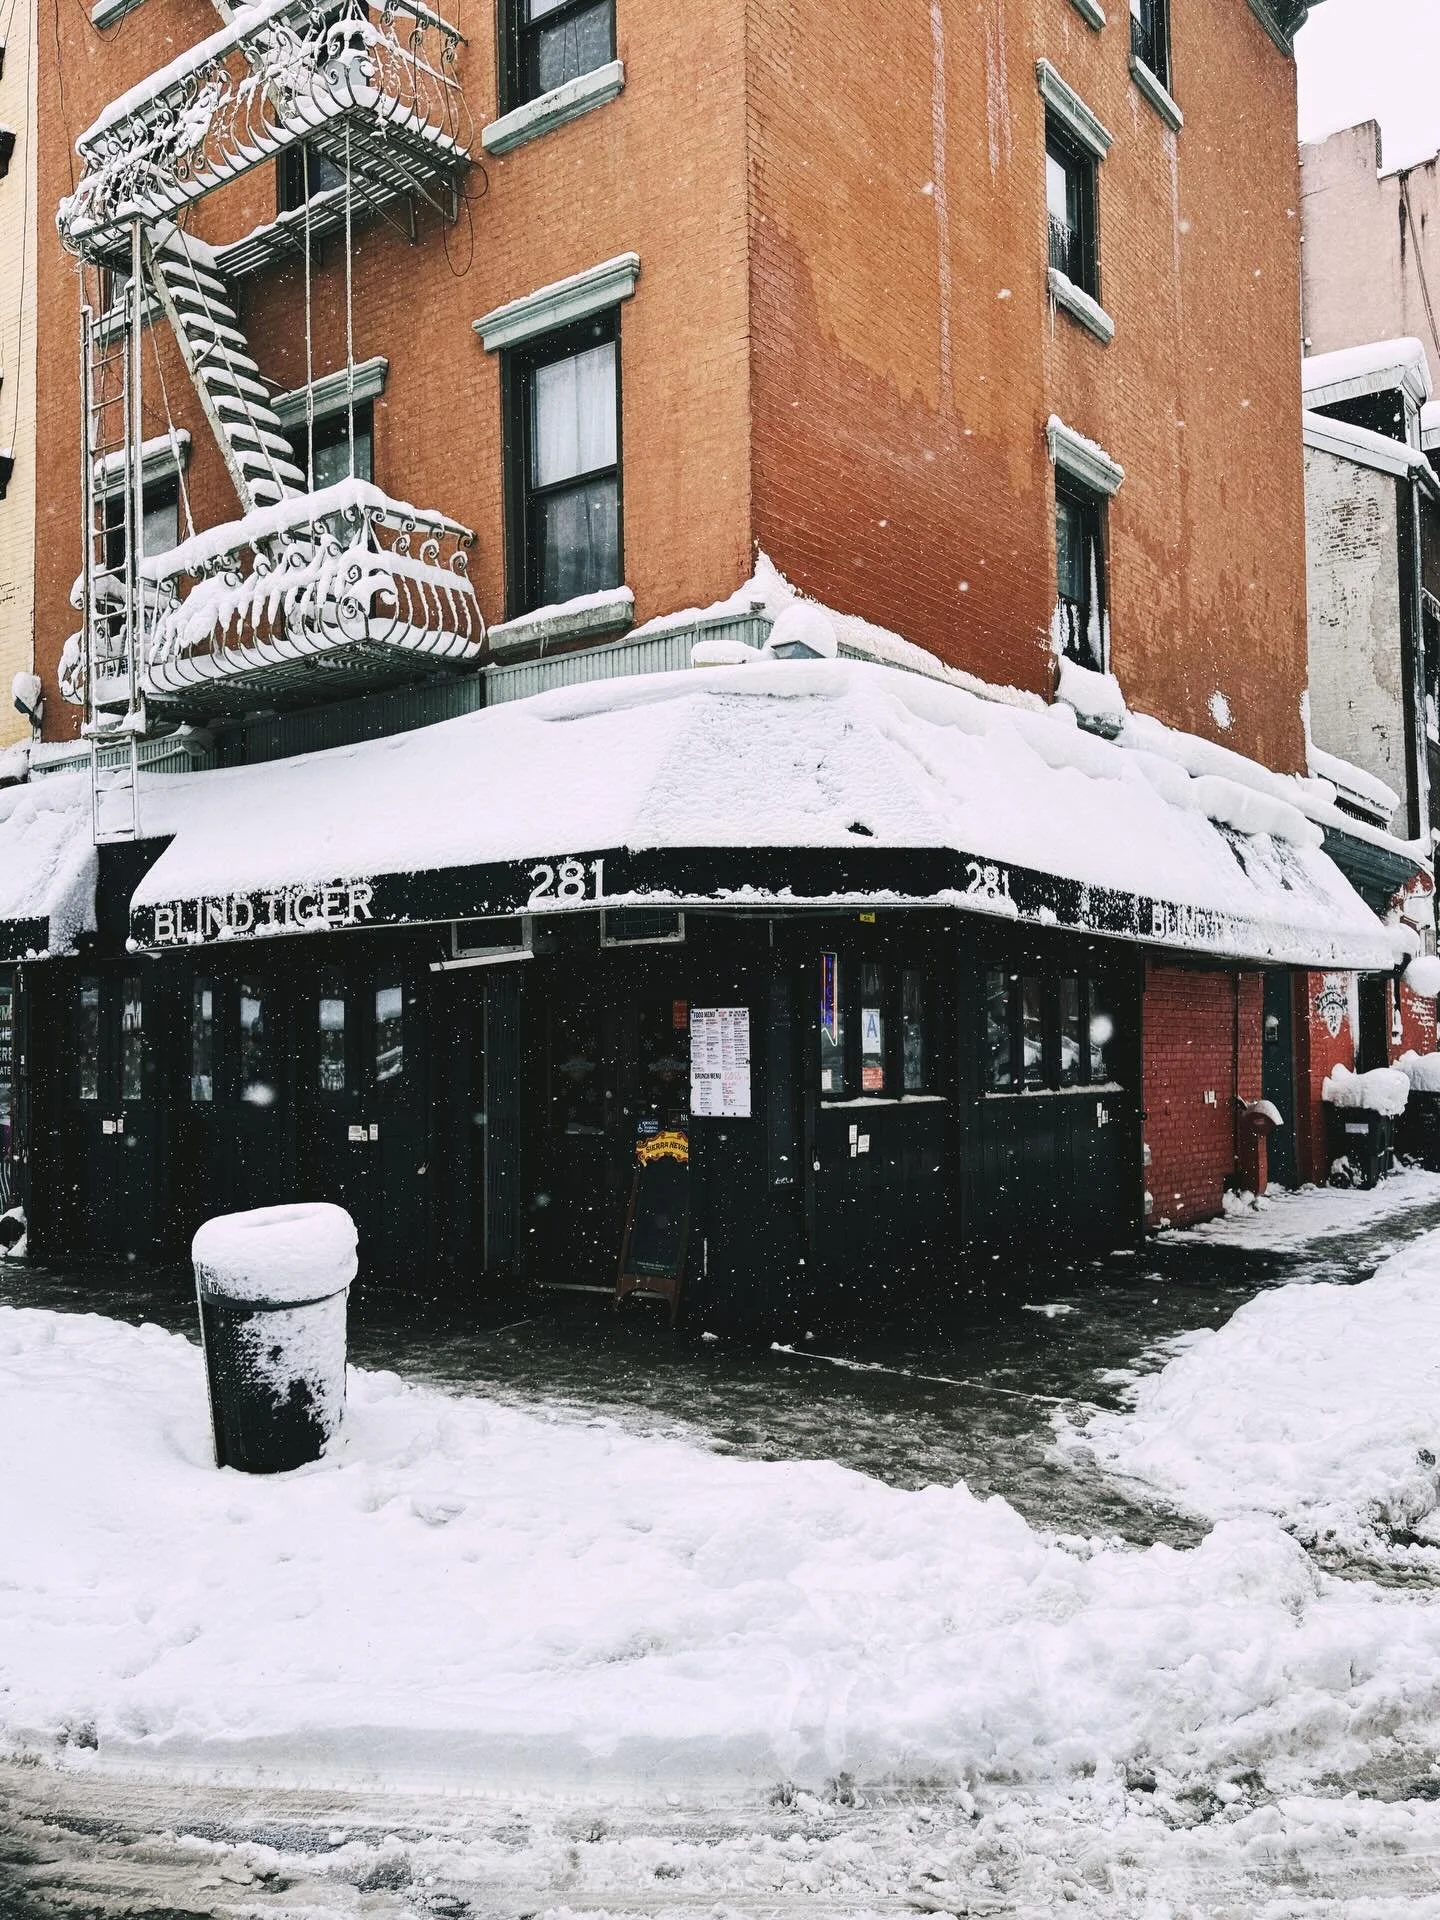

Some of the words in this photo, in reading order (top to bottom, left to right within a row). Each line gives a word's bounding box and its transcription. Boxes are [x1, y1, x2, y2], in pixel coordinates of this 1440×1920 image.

[528, 860, 605, 903] 281
[965, 862, 1009, 899] 281
[154, 892, 254, 940] BLIND
[262, 883, 375, 927] TIGER
[867, 1014, 878, 1038] A
[646, 1142, 669, 1153] SIERRA
